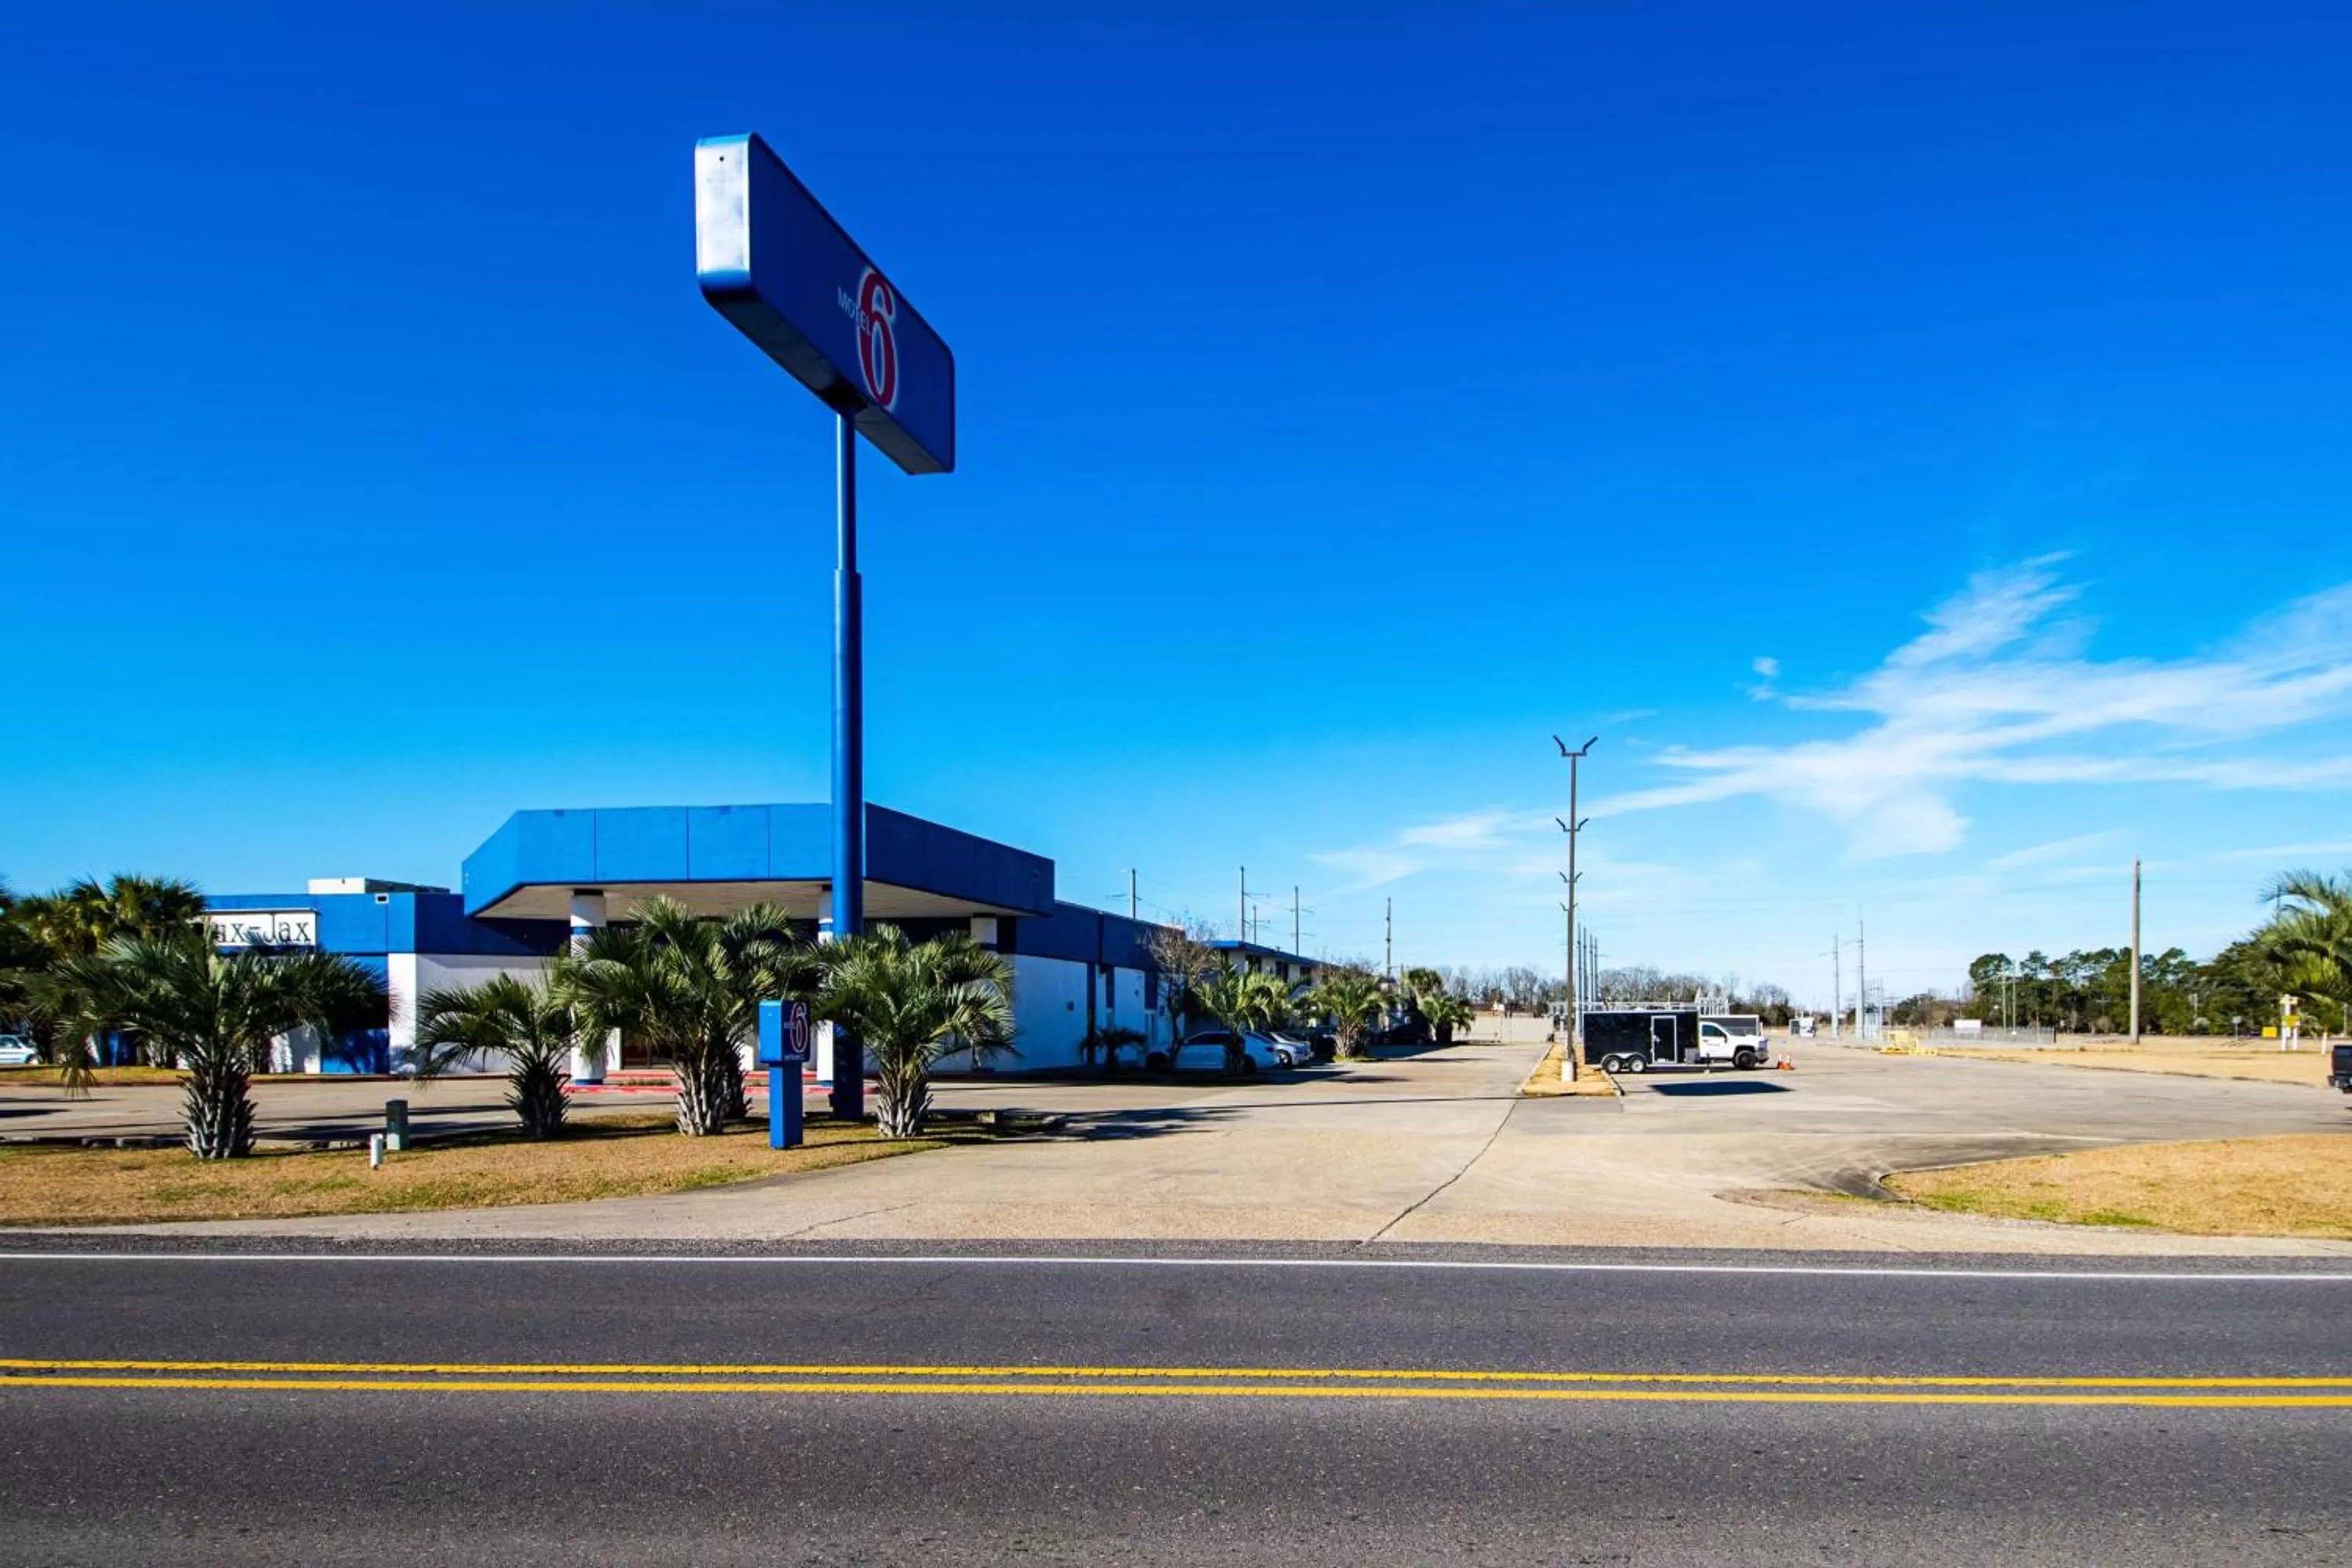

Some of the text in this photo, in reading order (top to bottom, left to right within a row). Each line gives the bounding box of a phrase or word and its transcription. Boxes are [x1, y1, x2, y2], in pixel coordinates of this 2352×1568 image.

[837, 265, 898, 413] MOTEL 6
[790, 1002, 808, 1053] 6
